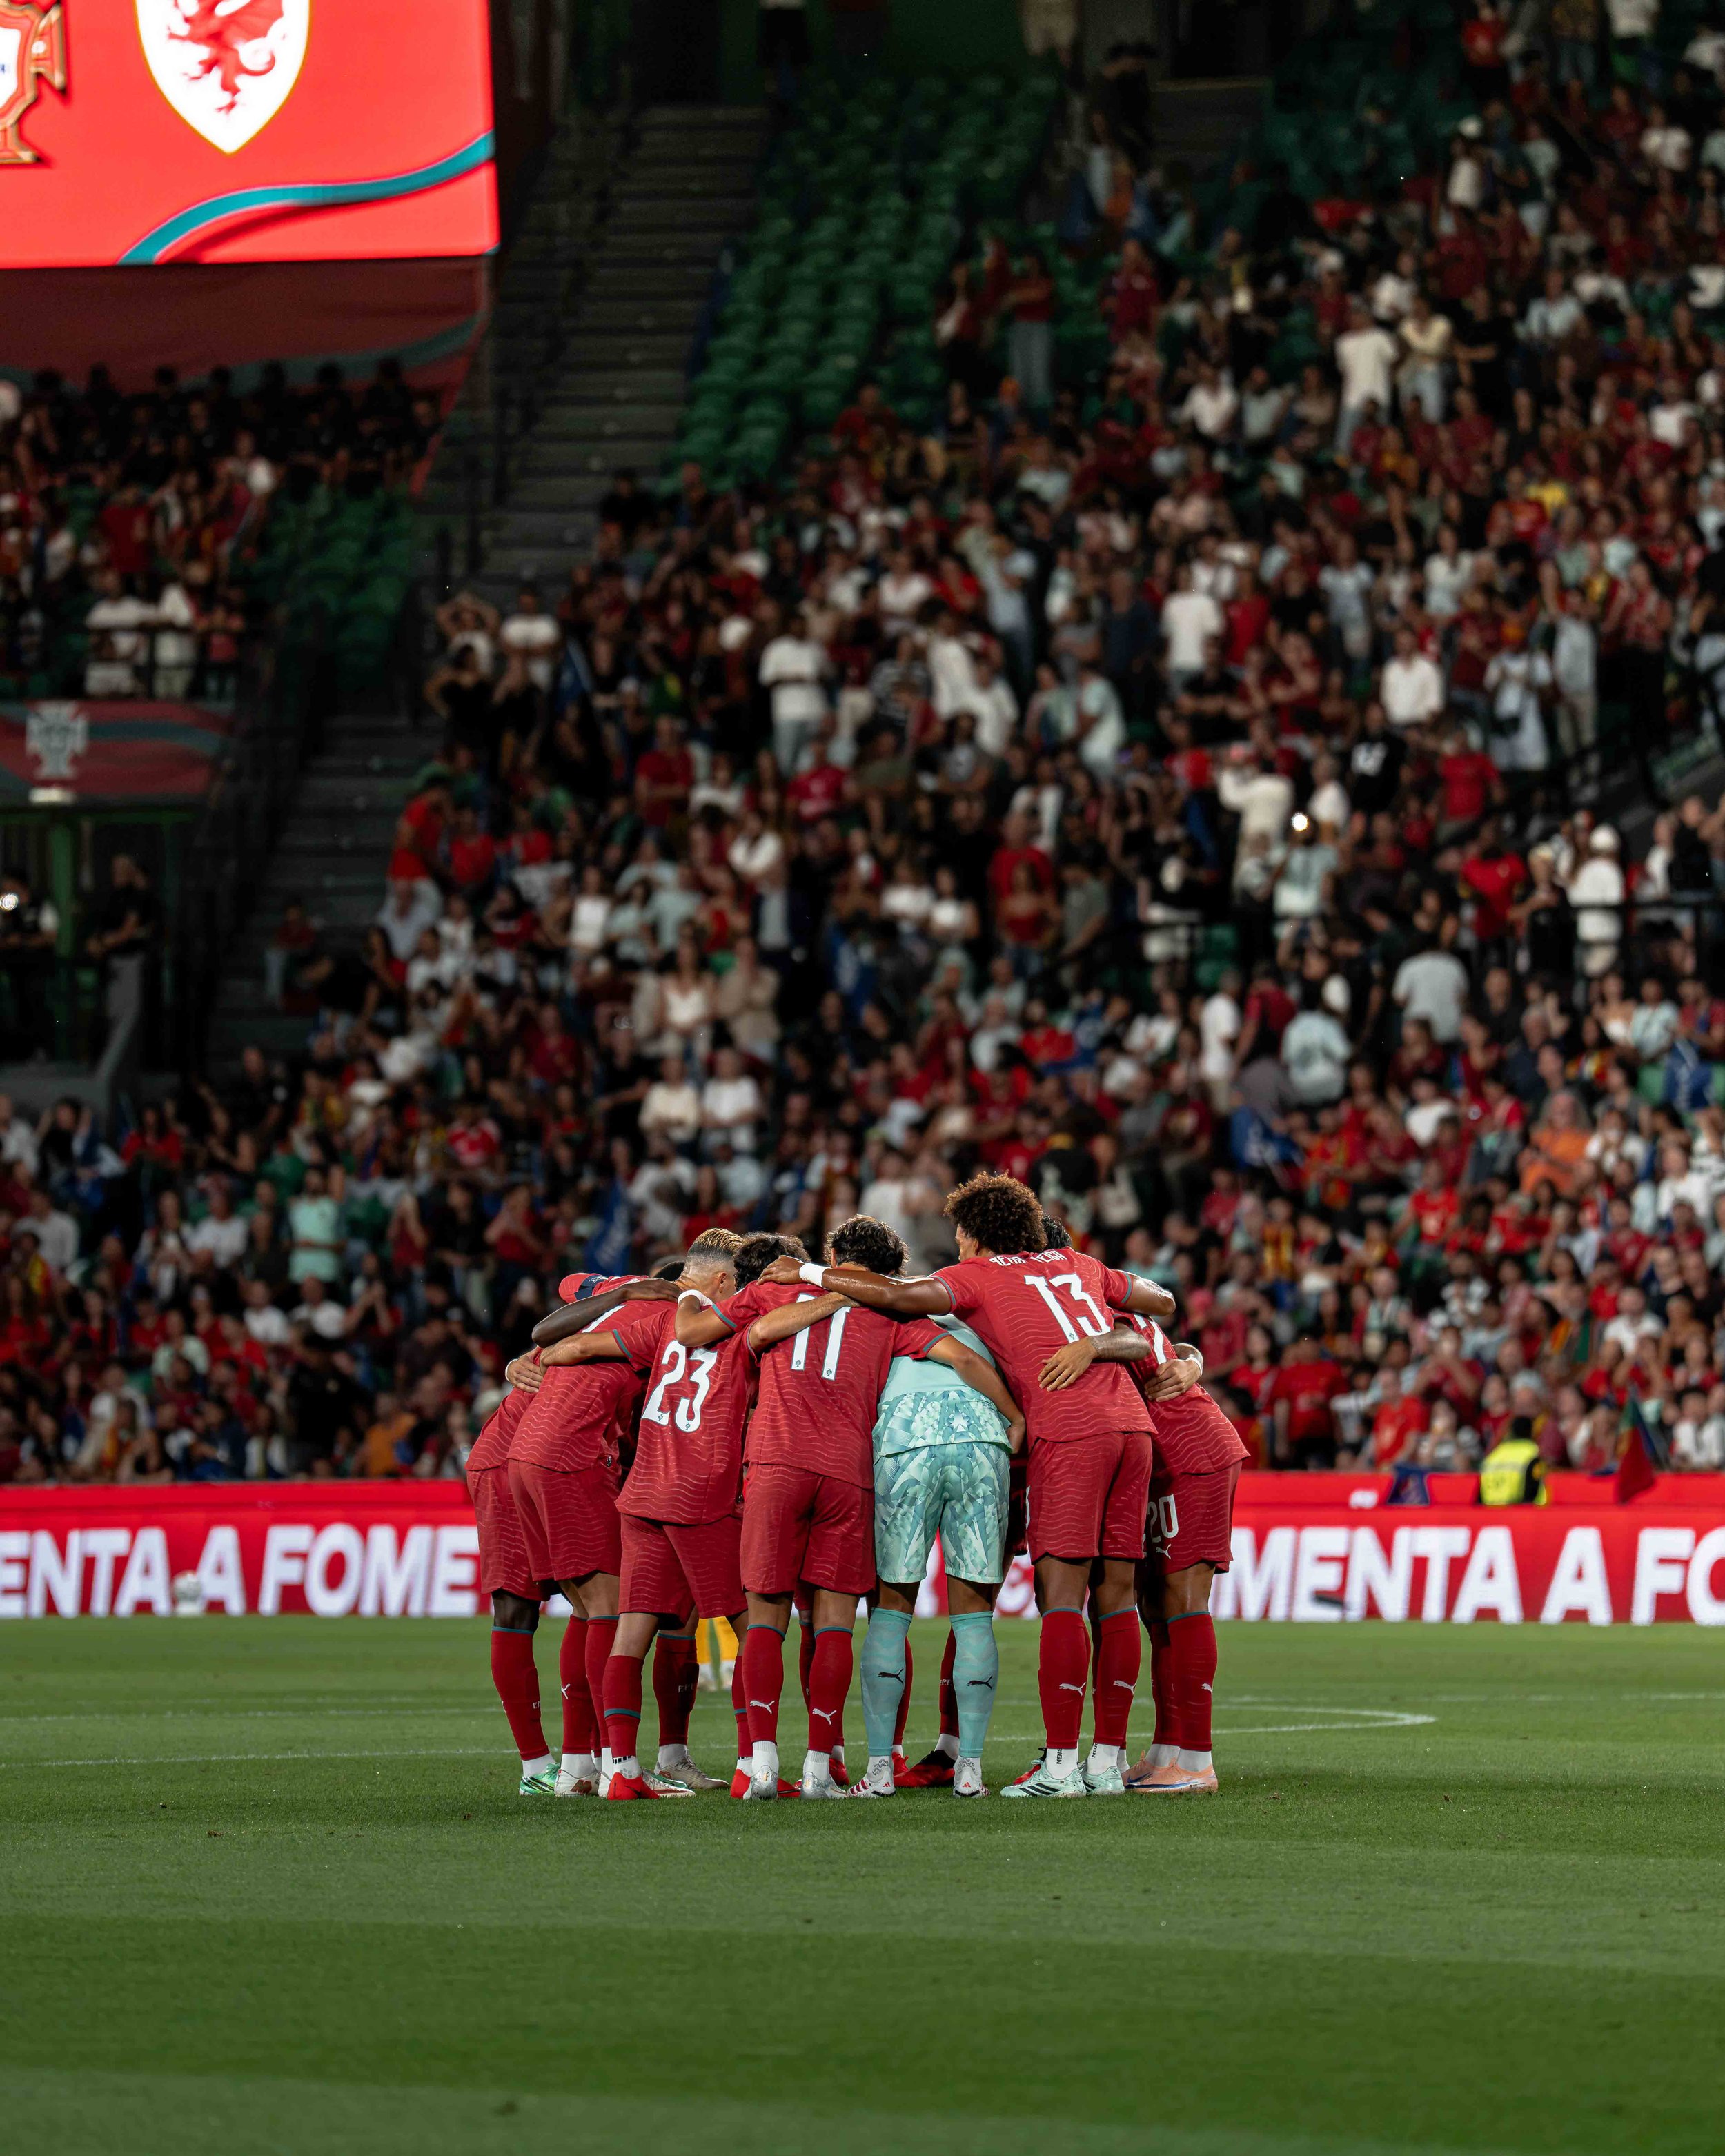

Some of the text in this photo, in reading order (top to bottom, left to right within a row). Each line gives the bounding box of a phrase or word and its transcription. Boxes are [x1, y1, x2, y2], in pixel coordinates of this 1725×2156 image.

[1023, 1273, 1111, 1343] 13
[642, 1340, 718, 1432] 23
[1147, 1494, 1179, 1543] 20
[195, 1525, 246, 1616] A
[1540, 1527, 1613, 1625] A
